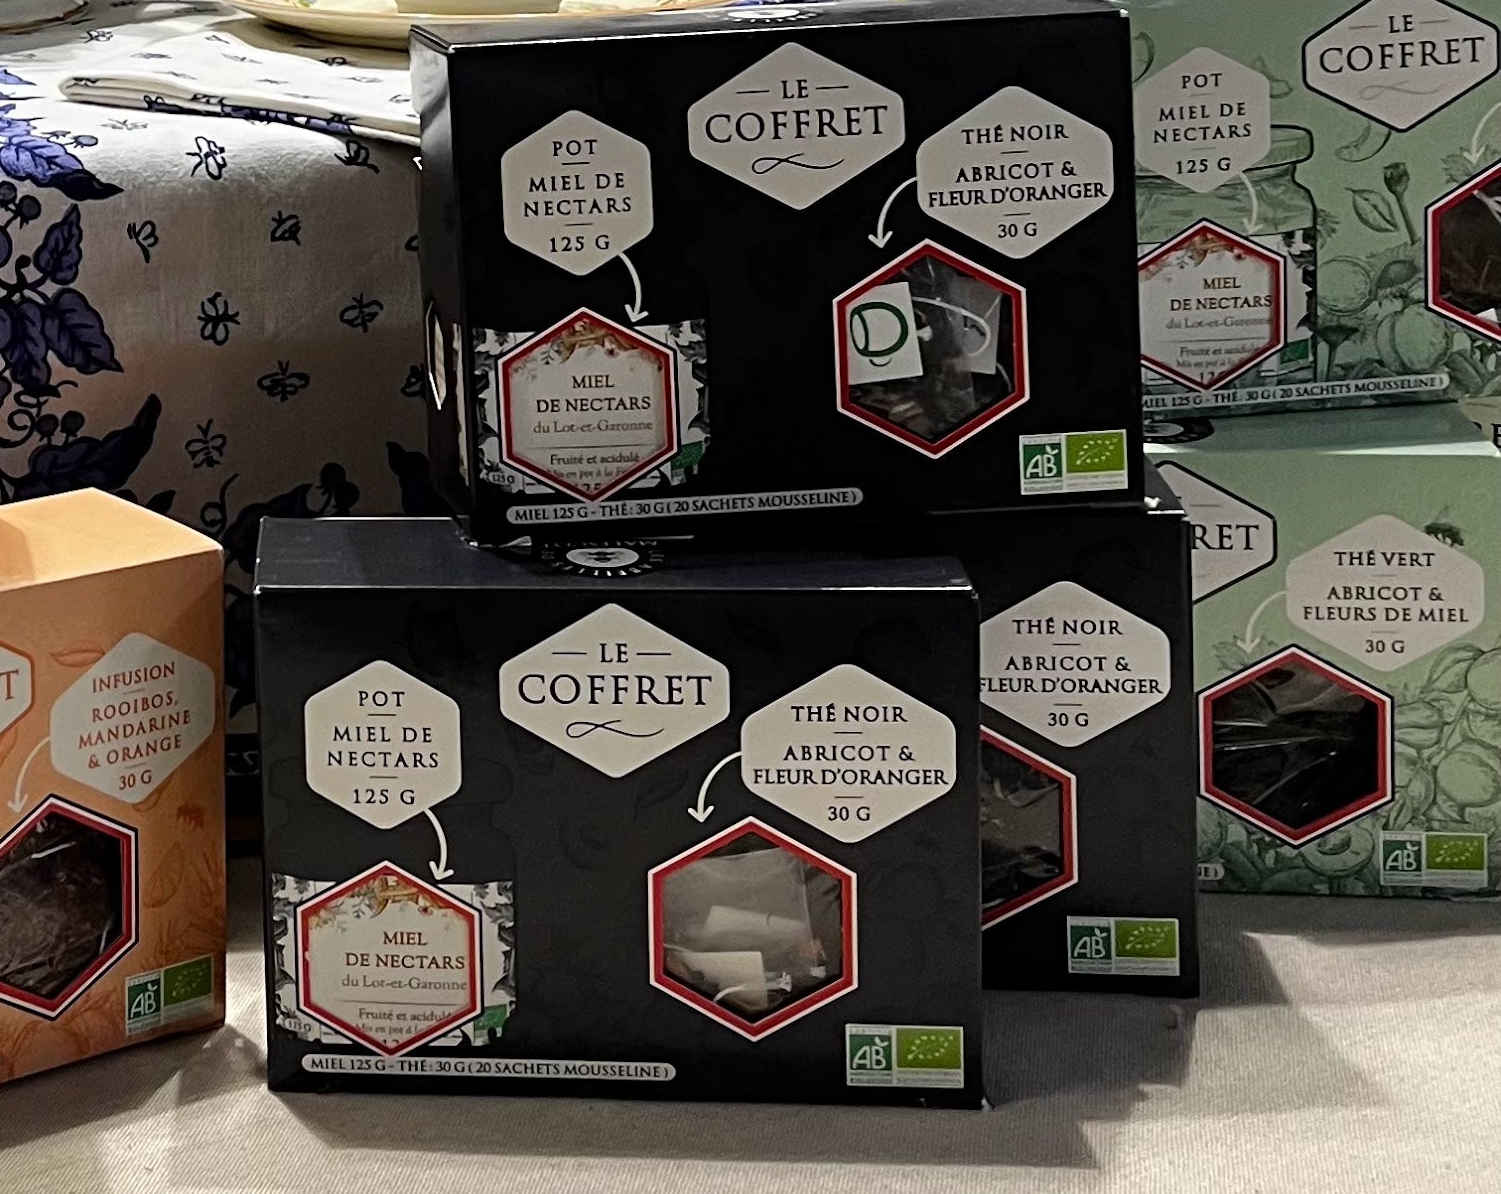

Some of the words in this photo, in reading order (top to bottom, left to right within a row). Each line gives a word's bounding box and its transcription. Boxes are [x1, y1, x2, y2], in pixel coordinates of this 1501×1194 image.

[1388, 14, 1415, 34] LE
[1319, 36, 1487, 74] COFFRET
[781, 79, 809, 100] LE
[1181, 73, 1224, 90] POT
[1159, 104, 1211, 123] MIEL
[1219, 102, 1247, 118] DE
[704, 105, 890, 145] COFFRET
[961, 125, 1004, 145] THÉ
[1011, 124, 1070, 143] NOIR
[1153, 123, 1252, 145] NECTARS
[551, 138, 599, 158] POT
[955, 162, 1055, 184] ABRICOT
[1060, 160, 1078, 178] &
[1175, 159, 1210, 176] 125
[1216, 157, 1232, 173] G
[527, 174, 586, 194] MIEL
[594, 171, 626, 191] DE
[928, 190, 989, 208] FLEUR
[990, 182, 1109, 205] D'ORANGER
[522, 196, 633, 219] NECTARS
[997, 223, 1019, 239] 30
[1024, 222, 1039, 238] G
[549, 235, 586, 254] 125
[594, 234, 611, 252] G
[1026, 454, 1058, 479] AB
[1334, 549, 1376, 567] THÉ
[1380, 551, 1437, 568] VERT
[1326, 585, 1423, 602] ABRICOT
[1428, 586, 1446, 602] &
[1302, 607, 1377, 622] FLEURS
[1384, 607, 1412, 622] DE
[1417, 608, 1471, 623] MIEL
[1012, 617, 1056, 635] THÉ
[1062, 619, 1124, 635] NOIR
[599, 643, 629, 664] LE
[1365, 639, 1386, 654] 30
[1391, 639, 1406, 654] G
[1004, 656, 1108, 672] ABRICOT
[1115, 656, 1132, 672] &
[517, 674, 713, 706] COFFRET
[980, 677, 1038, 693] FLEUR
[1041, 677, 1164, 694] D'ORANGER
[790, 702, 837, 723] THÉ
[843, 705, 909, 723] NOIR
[1048, 712, 1069, 728] 30
[1075, 713, 1090, 728] G
[782, 744, 892, 762] ABRICOT
[898, 745, 916, 762] &
[752, 768, 820, 786] FLEUR
[820, 768, 950, 786] D'ORANGER
[828, 806, 850, 822] 30
[856, 805, 872, 822] G
[1385, 849, 1418, 872] AB
[1074, 936, 1106, 959] AB
